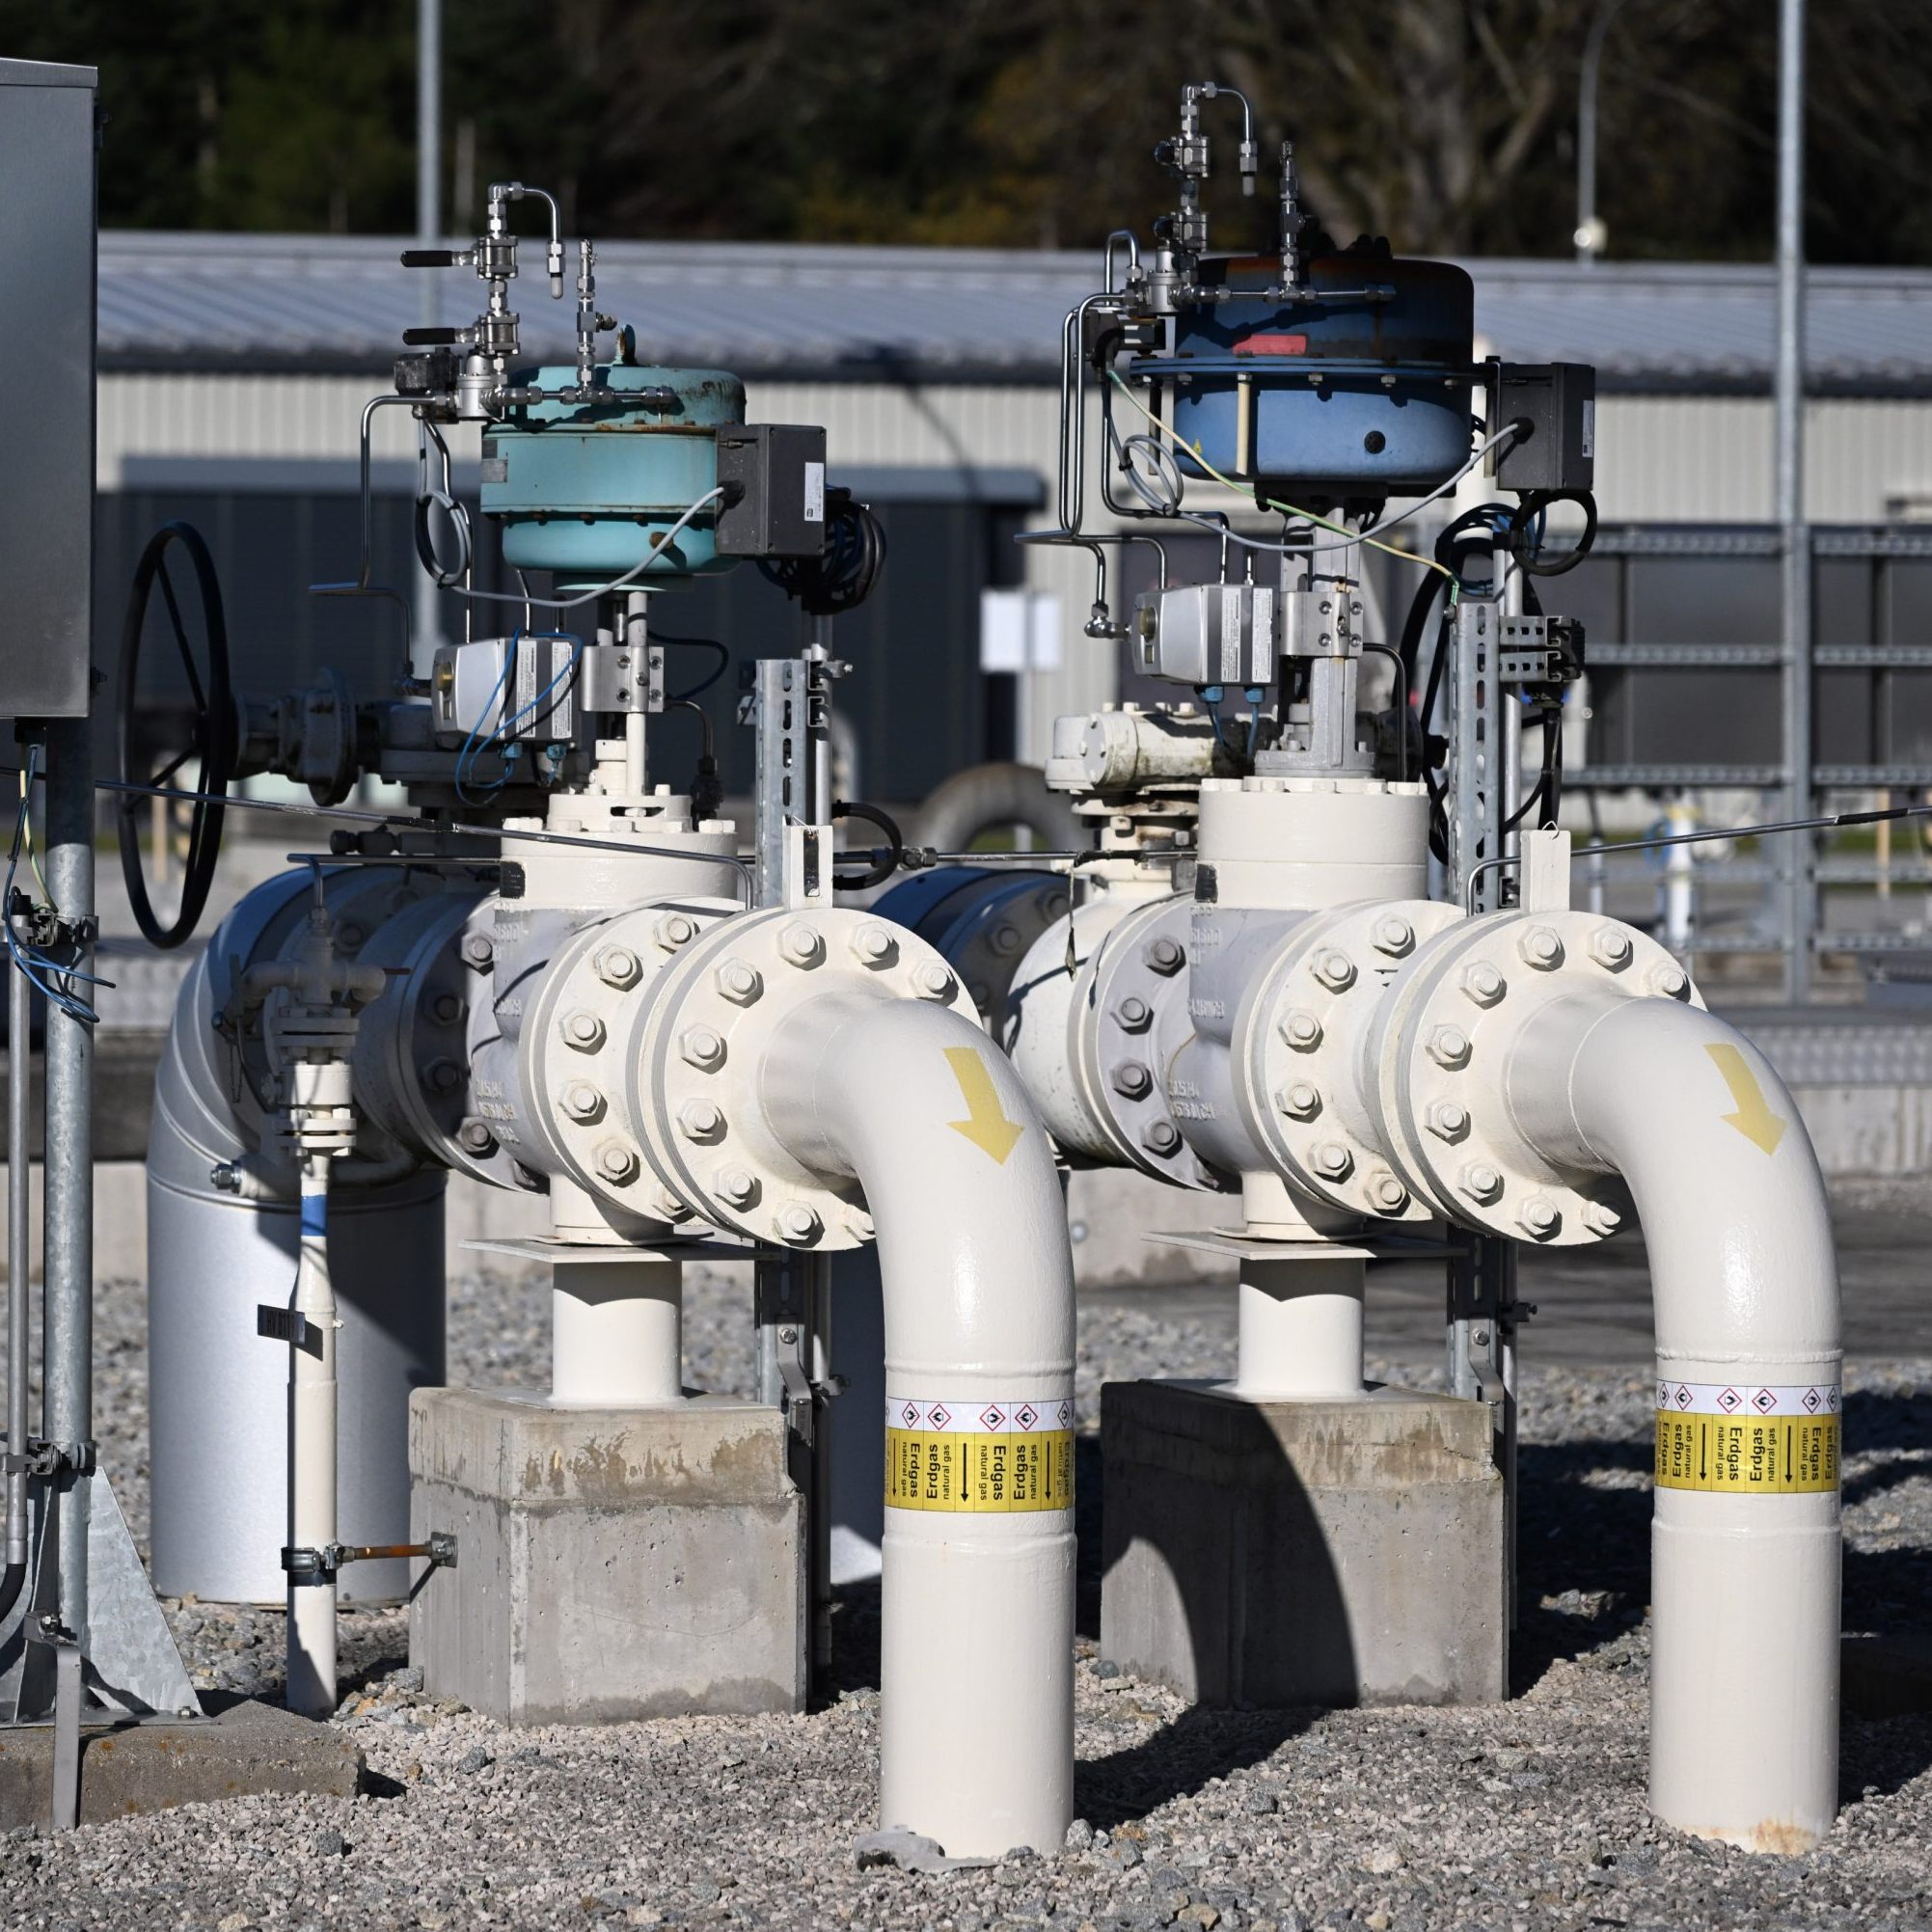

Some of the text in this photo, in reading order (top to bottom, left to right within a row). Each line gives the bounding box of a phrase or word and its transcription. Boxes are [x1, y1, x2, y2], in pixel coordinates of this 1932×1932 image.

[909, 1443, 920, 1498] Erdgas
[927, 1444, 940, 1499] Erdgas
[992, 1446, 1006, 1501] Erdgas
[1014, 1445, 1028, 1500] Erdgas
[1673, 1424, 1683, 1477] Erdgas
[1727, 1428, 1742, 1482] Erdgas
[1750, 1428, 1765, 1482] Erdgas
[1810, 1428, 1821, 1481] Erdgas
